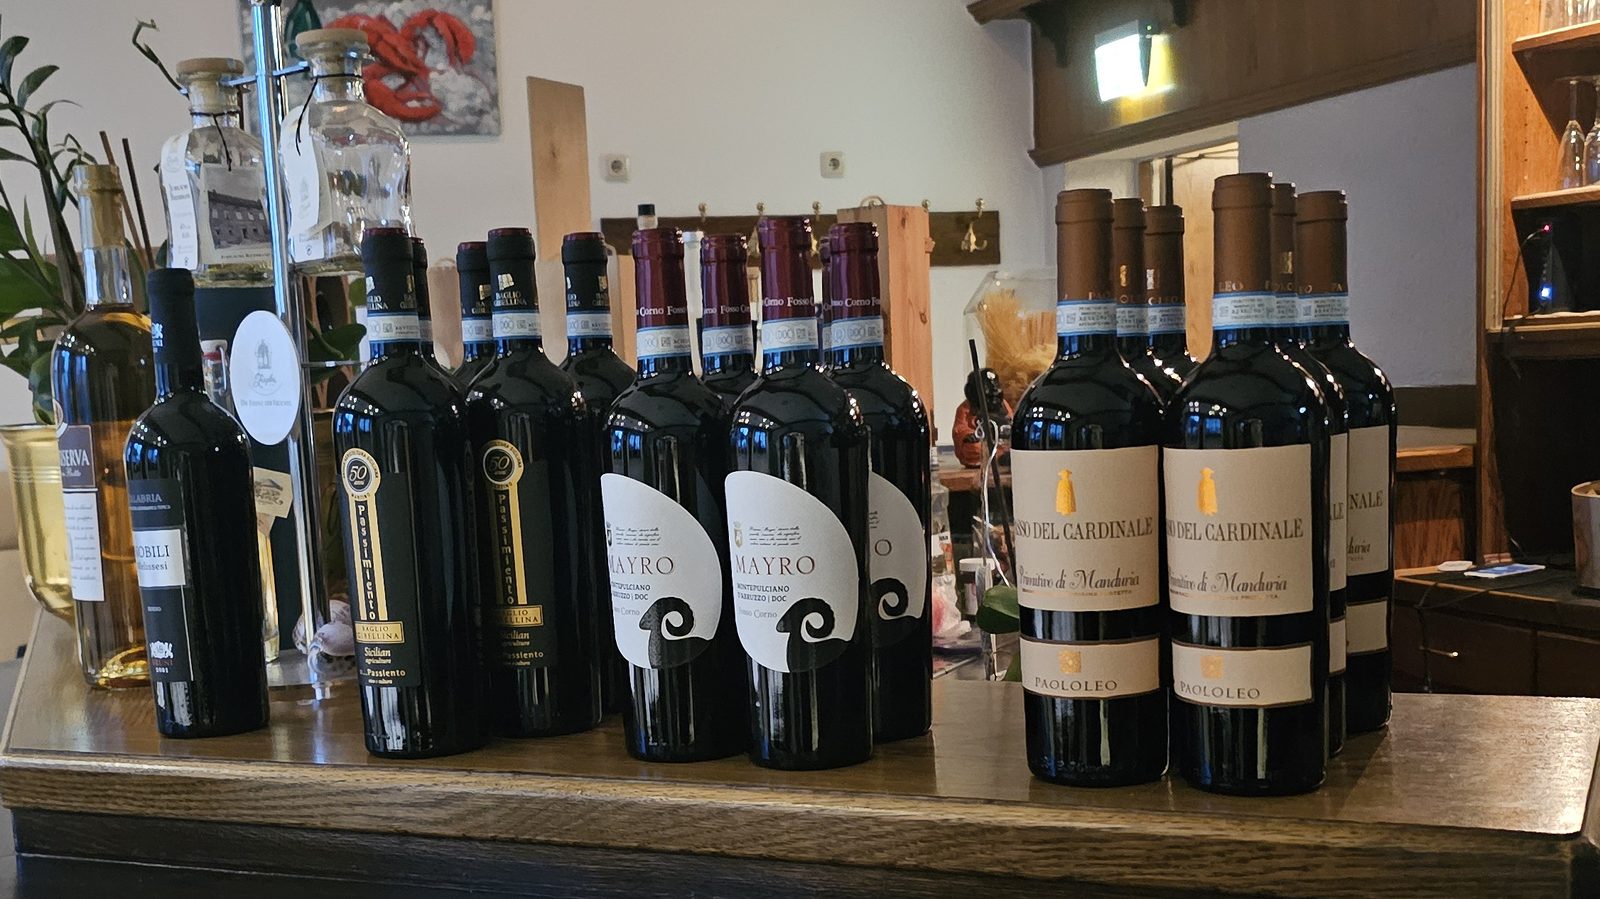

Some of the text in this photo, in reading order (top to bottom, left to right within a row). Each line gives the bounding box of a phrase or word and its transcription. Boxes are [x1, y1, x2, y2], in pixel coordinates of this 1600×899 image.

[787, 296, 810, 307] Fosso
[844, 298, 871, 308] Corno
[640, 306, 665, 317] Corno
[350, 465, 367, 482] 50
[1033, 522, 1060, 540] DEL
[1062, 516, 1153, 541] CARDINALE
[1177, 521, 1202, 541] DEL
[1204, 518, 1304, 542] CARDINALE
[736, 554, 815, 576] MAYRO
[1055, 568, 1067, 589] di
[1070, 567, 1140, 590] Manduria
[1196, 571, 1208, 592] di
[1210, 571, 1288, 593] Manduria
[771, 594, 787, 602] DOC
[620, 606, 640, 617] Corno
[753, 607, 778, 619] Corno
[1034, 676, 1118, 692] PAOLOLEO
[1179, 681, 1260, 700] PAOLOLEO
